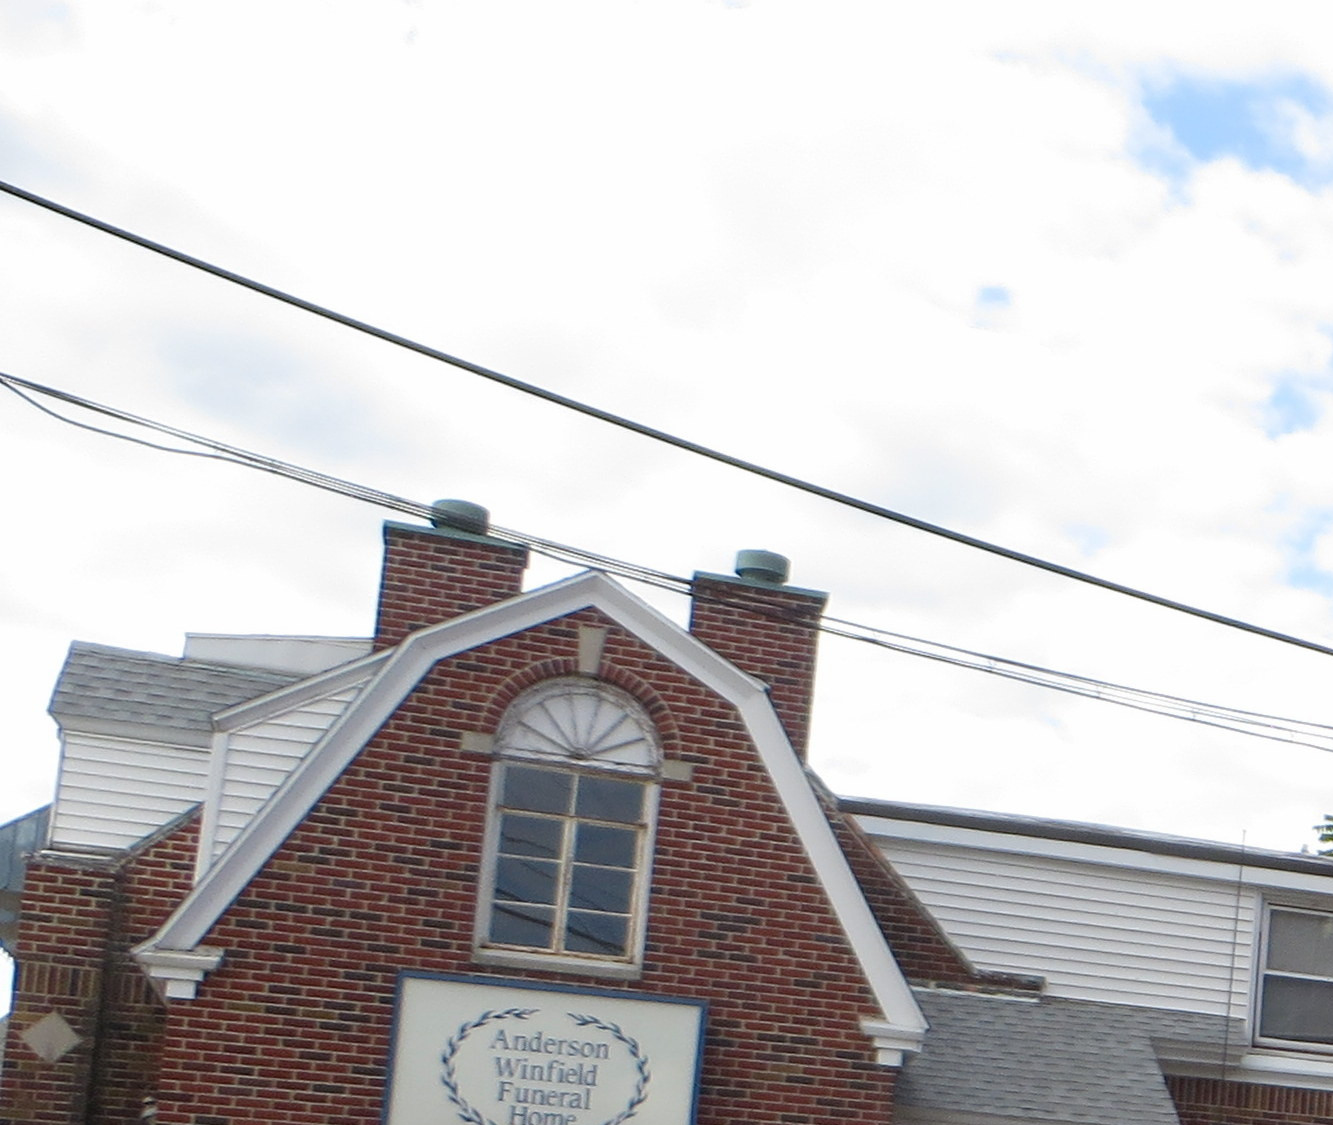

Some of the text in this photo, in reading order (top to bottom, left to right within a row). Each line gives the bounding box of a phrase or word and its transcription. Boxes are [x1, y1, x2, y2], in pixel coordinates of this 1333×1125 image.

[490, 1029, 610, 1060] Anderson
[495, 1057, 598, 1087] Winfield
[498, 1081, 591, 1110] Funeral
